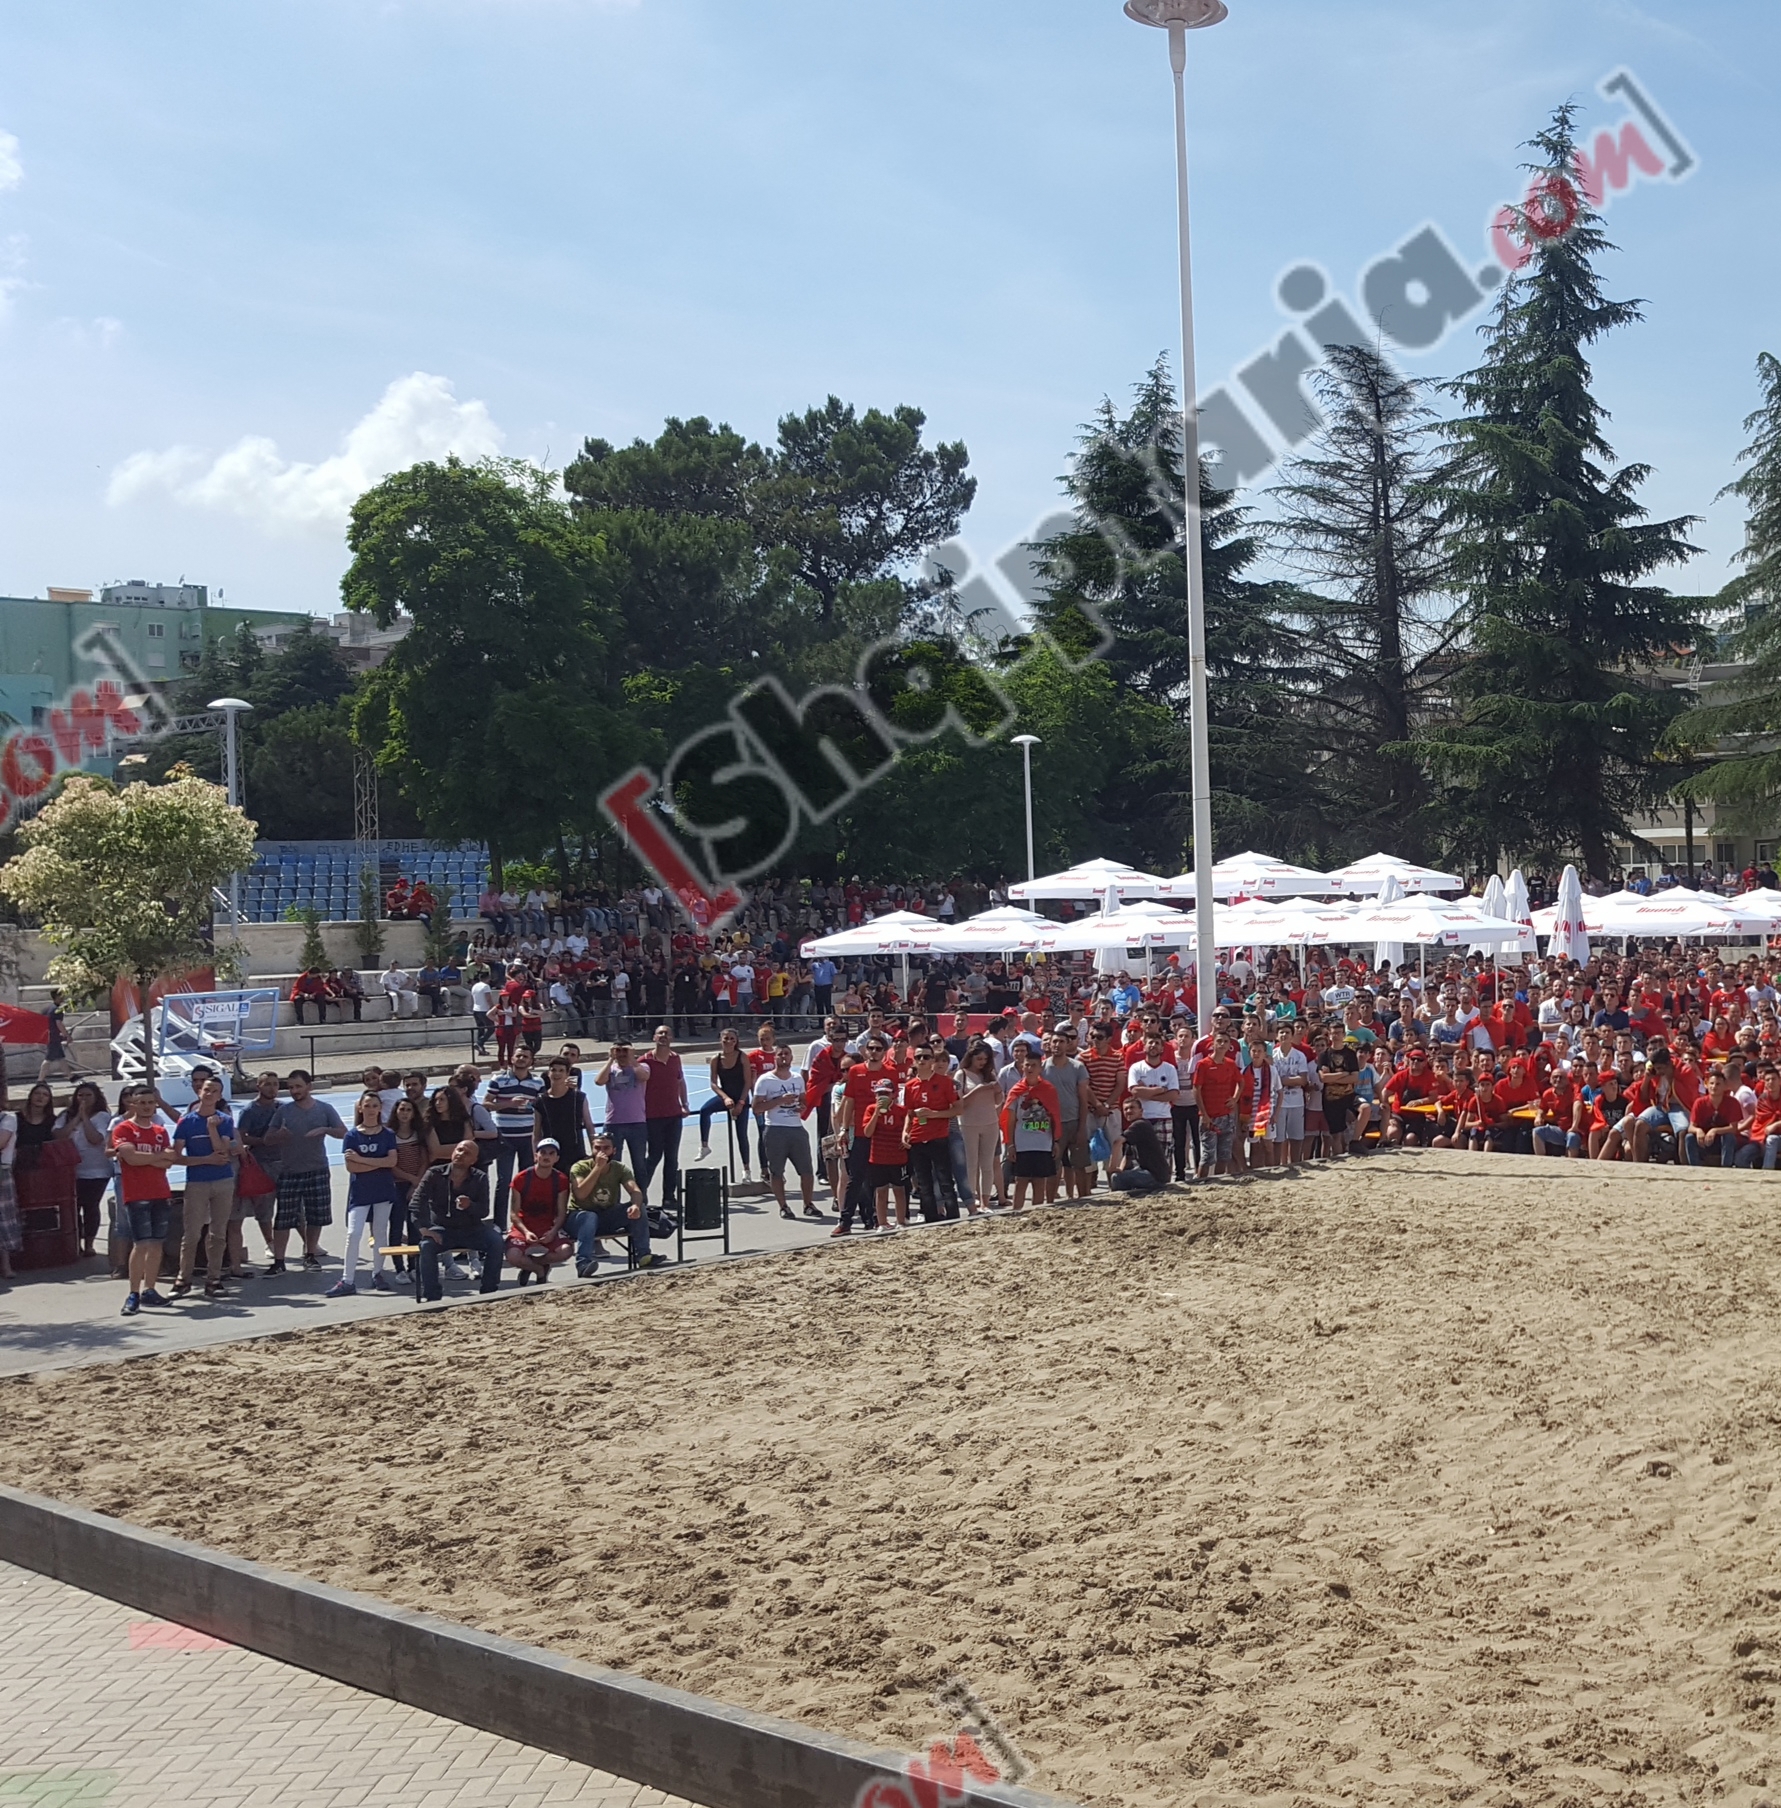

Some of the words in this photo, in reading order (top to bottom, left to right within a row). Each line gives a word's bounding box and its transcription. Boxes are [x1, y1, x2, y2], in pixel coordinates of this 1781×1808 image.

[205, 1003, 239, 1013] SIGAL
[921, 1092, 928, 1102] 5
[884, 1115, 894, 1125] 14
